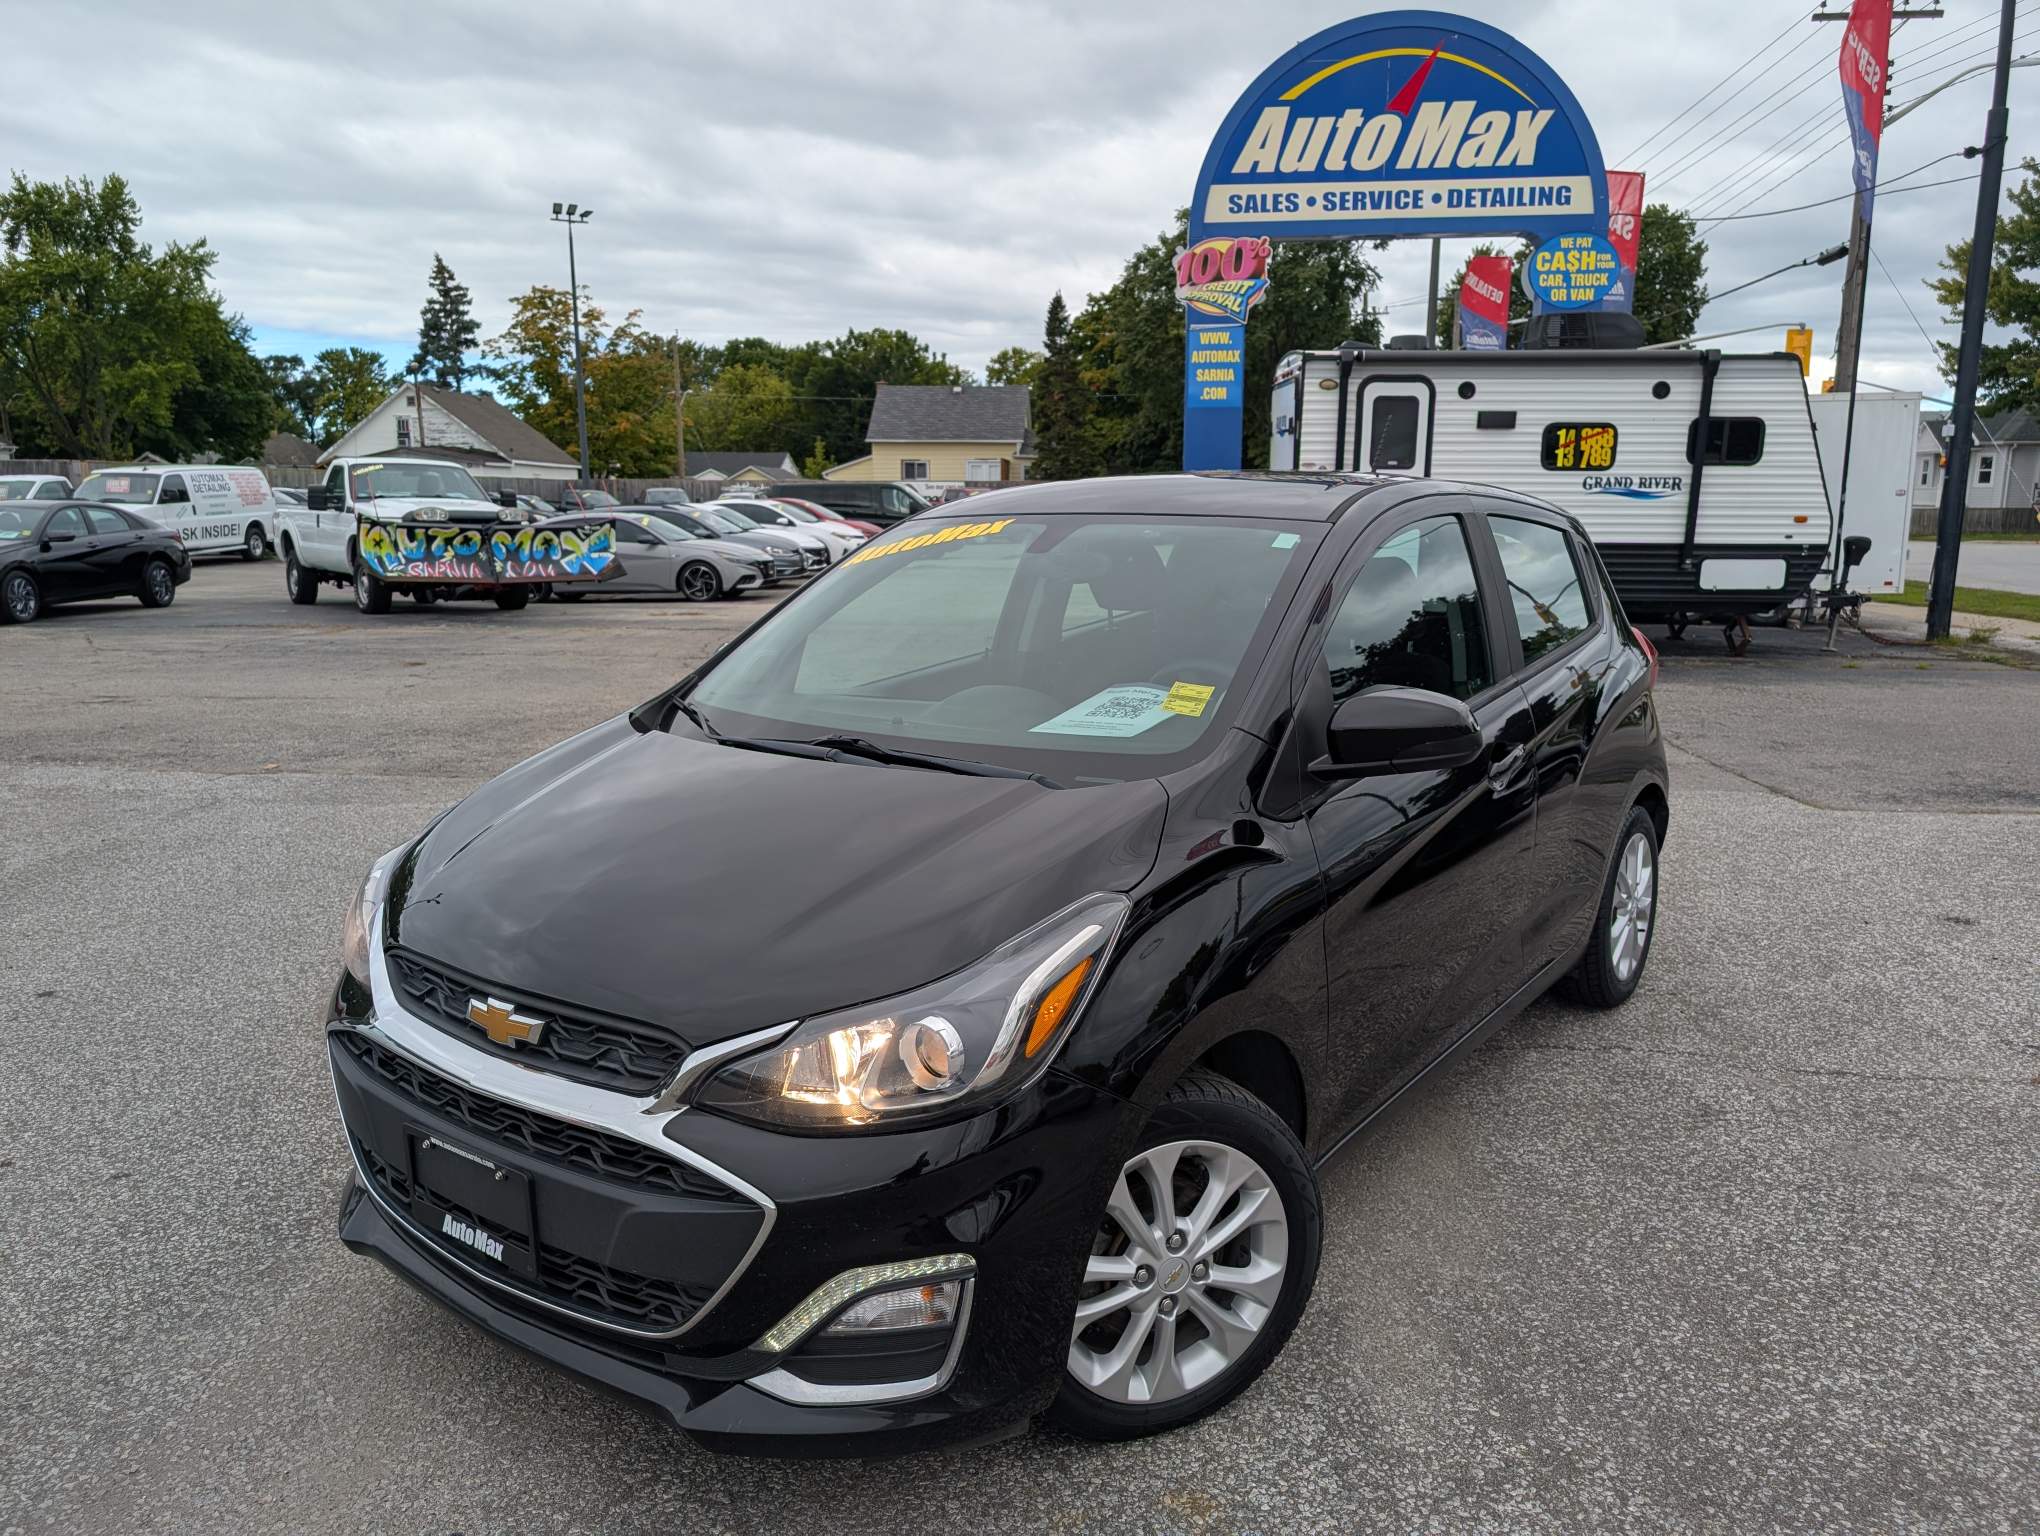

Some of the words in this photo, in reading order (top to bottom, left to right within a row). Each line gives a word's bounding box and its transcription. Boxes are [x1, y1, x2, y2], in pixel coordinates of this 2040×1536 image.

[1228, 192, 1300, 214] SALES
[1322, 189, 1424, 212] SERVICE
[1446, 185, 1572, 208] DETAILING
[1560, 237, 1574, 249] WE
[1576, 237, 1593, 249] PAY
[1176, 236, 1271, 287] 100%
[1536, 250, 1597, 273] CA$H
[1597, 253, 1611, 261] FOR
[1597, 261, 1616, 269] YOUR
[1539, 274, 1567, 288] CAR,
[1570, 272, 1608, 286] TRUCK
[1202, 279, 1256, 296] CREDIT
[1551, 289, 1567, 301] OR
[1570, 288, 1595, 301] VAN
[1185, 289, 1242, 313] APPROVAL
[1199, 331, 1233, 345] WWW.
[1191, 350, 1241, 364] AUTOMAX
[1195, 368, 1235, 382] SARNIA
[1200, 387, 1228, 400] .COM
[190, 473, 226, 483] AUTOMAX
[1582, 476, 1633, 491] GRAND
[1638, 476, 1682, 491] RIVER
[193, 482, 232, 493] DETAILING
[201, 524, 240, 540] INSIDE!
